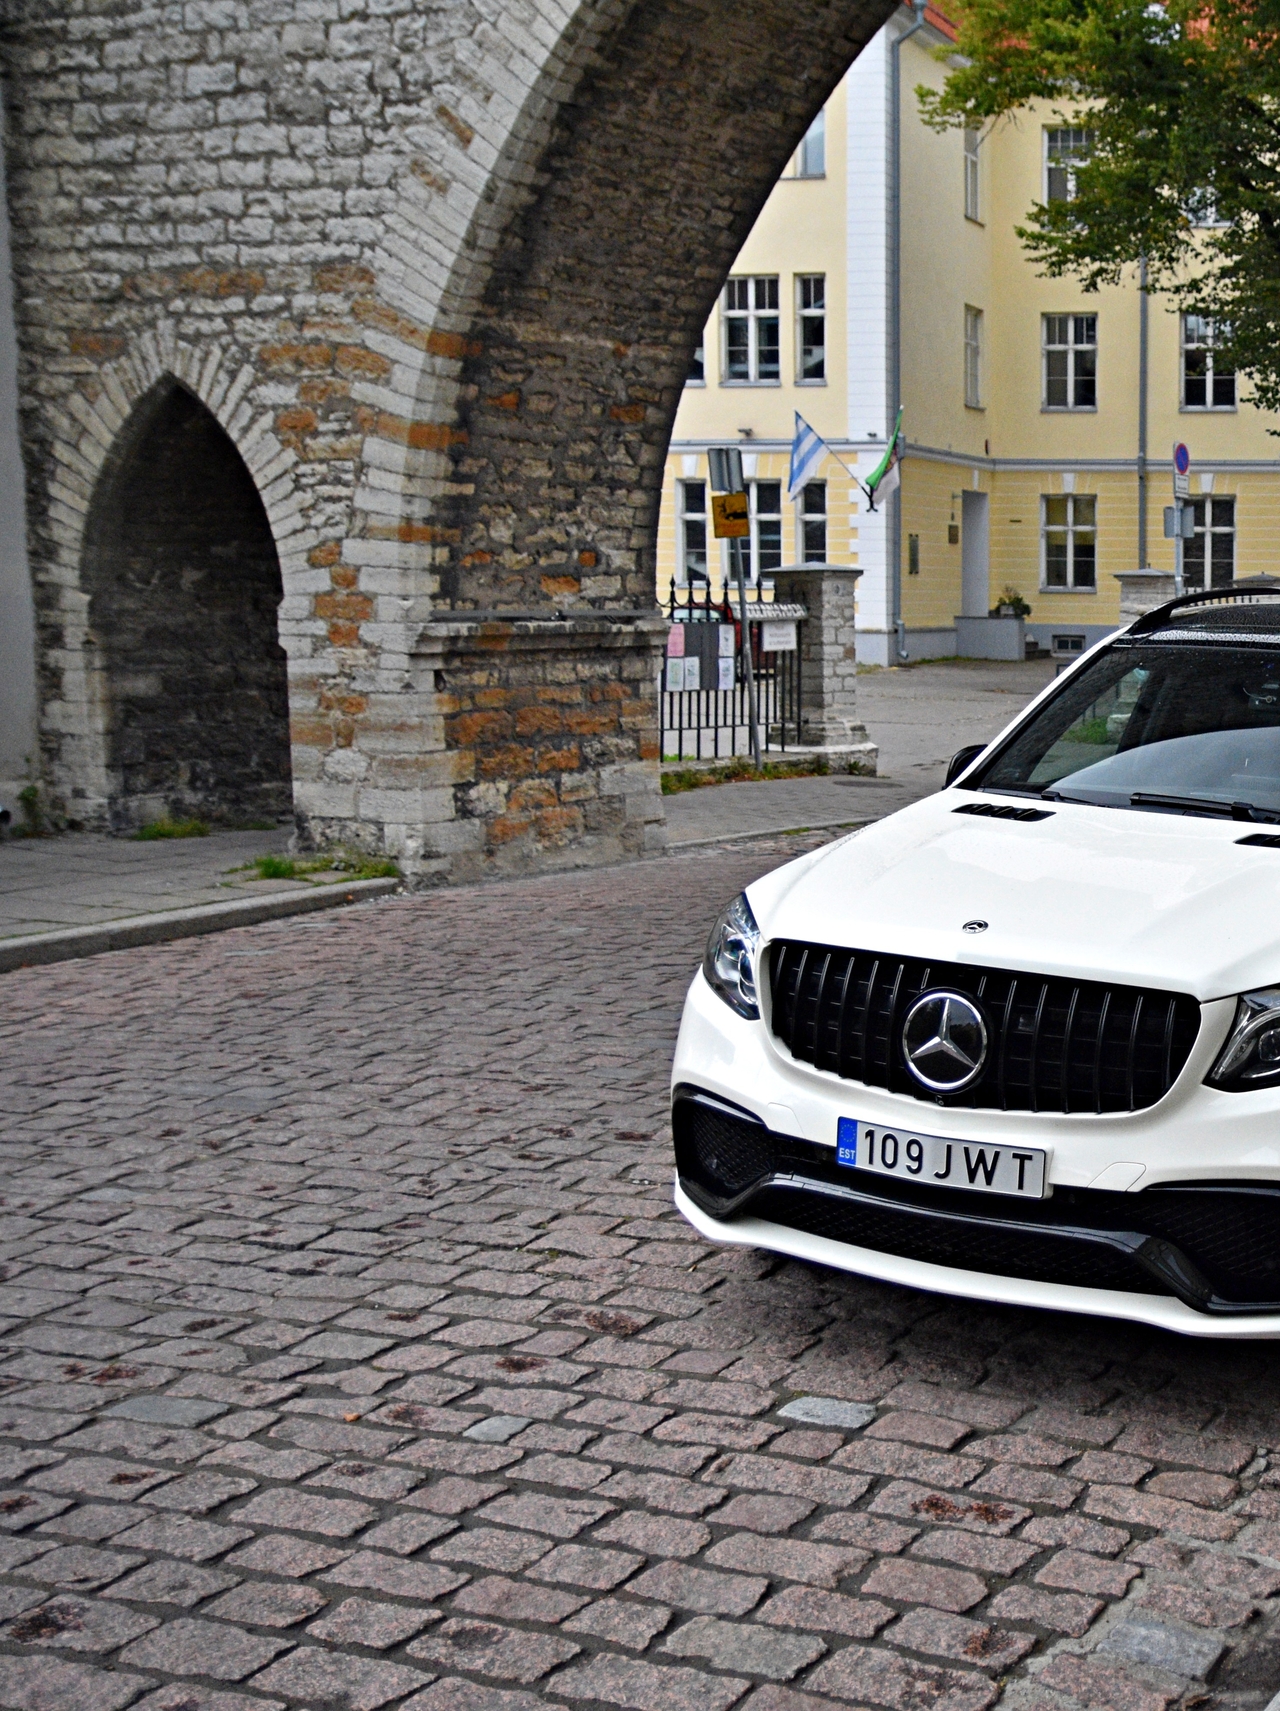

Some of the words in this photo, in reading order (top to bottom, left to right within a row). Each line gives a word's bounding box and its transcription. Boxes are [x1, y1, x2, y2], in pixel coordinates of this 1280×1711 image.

[838, 1147, 856, 1160] EST
[864, 1127, 924, 1175] 109
[933, 1143, 1033, 1190] JWT
